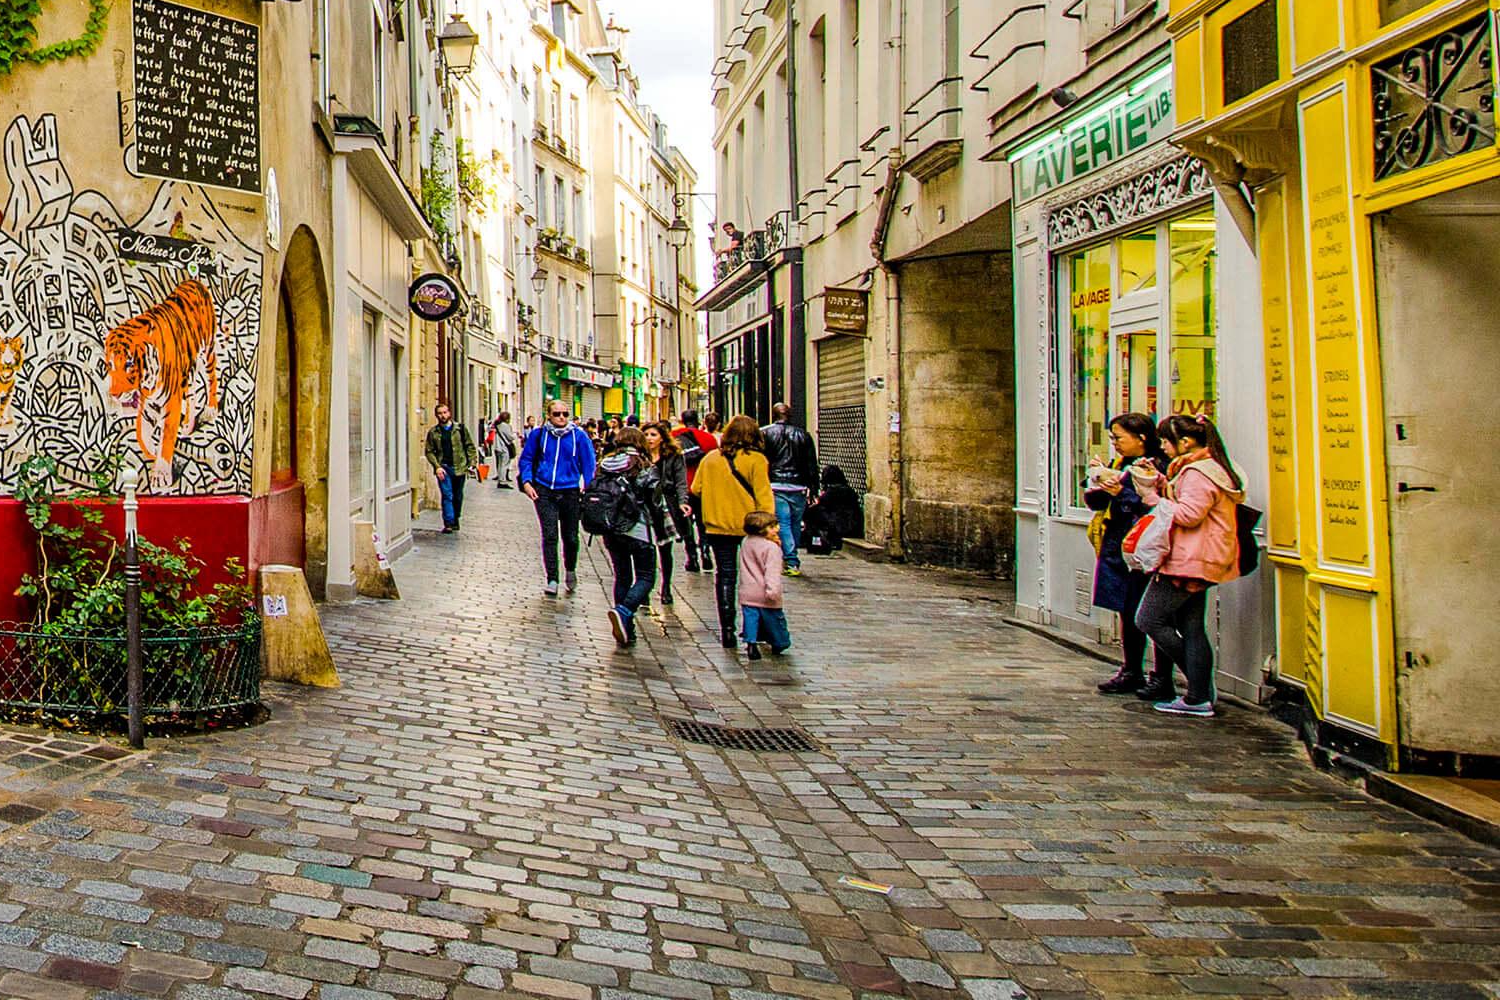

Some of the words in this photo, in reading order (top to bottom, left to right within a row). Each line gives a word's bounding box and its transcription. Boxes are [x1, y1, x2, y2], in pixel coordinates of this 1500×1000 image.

[135, 15, 148, 26] on
[159, 16, 174, 31] the
[185, 25, 202, 42] city
[173, 33, 192, 50] take
[201, 41, 216, 55] the
[136, 42, 155, 54] and
[169, 46, 183, 61] the
[199, 53, 227, 75] things
[239, 67, 255, 79] you
[136, 55, 163, 70] knew
[222, 75, 255, 91] beyond
[136, 70, 163, 84] what
[170, 74, 192, 96] they
[136, 101, 160, 112] your
[162, 105, 189, 117] mind
[192, 112, 212, 122] now
[180, 90, 195, 105] the
[247, 107, 255, 119] in
[137, 115, 173, 134] unsung
[240, 135, 256, 147] you
[138, 126, 161, 140] have
[184, 138, 213, 149] never
[231, 143, 256, 158] heard
[138, 142, 172, 157] except
[180, 148, 188, 160] in
[196, 153, 219, 166] your
[1019, 93, 1148, 199] LAVERIE
[1073, 288, 1110, 309] LAVAGE
